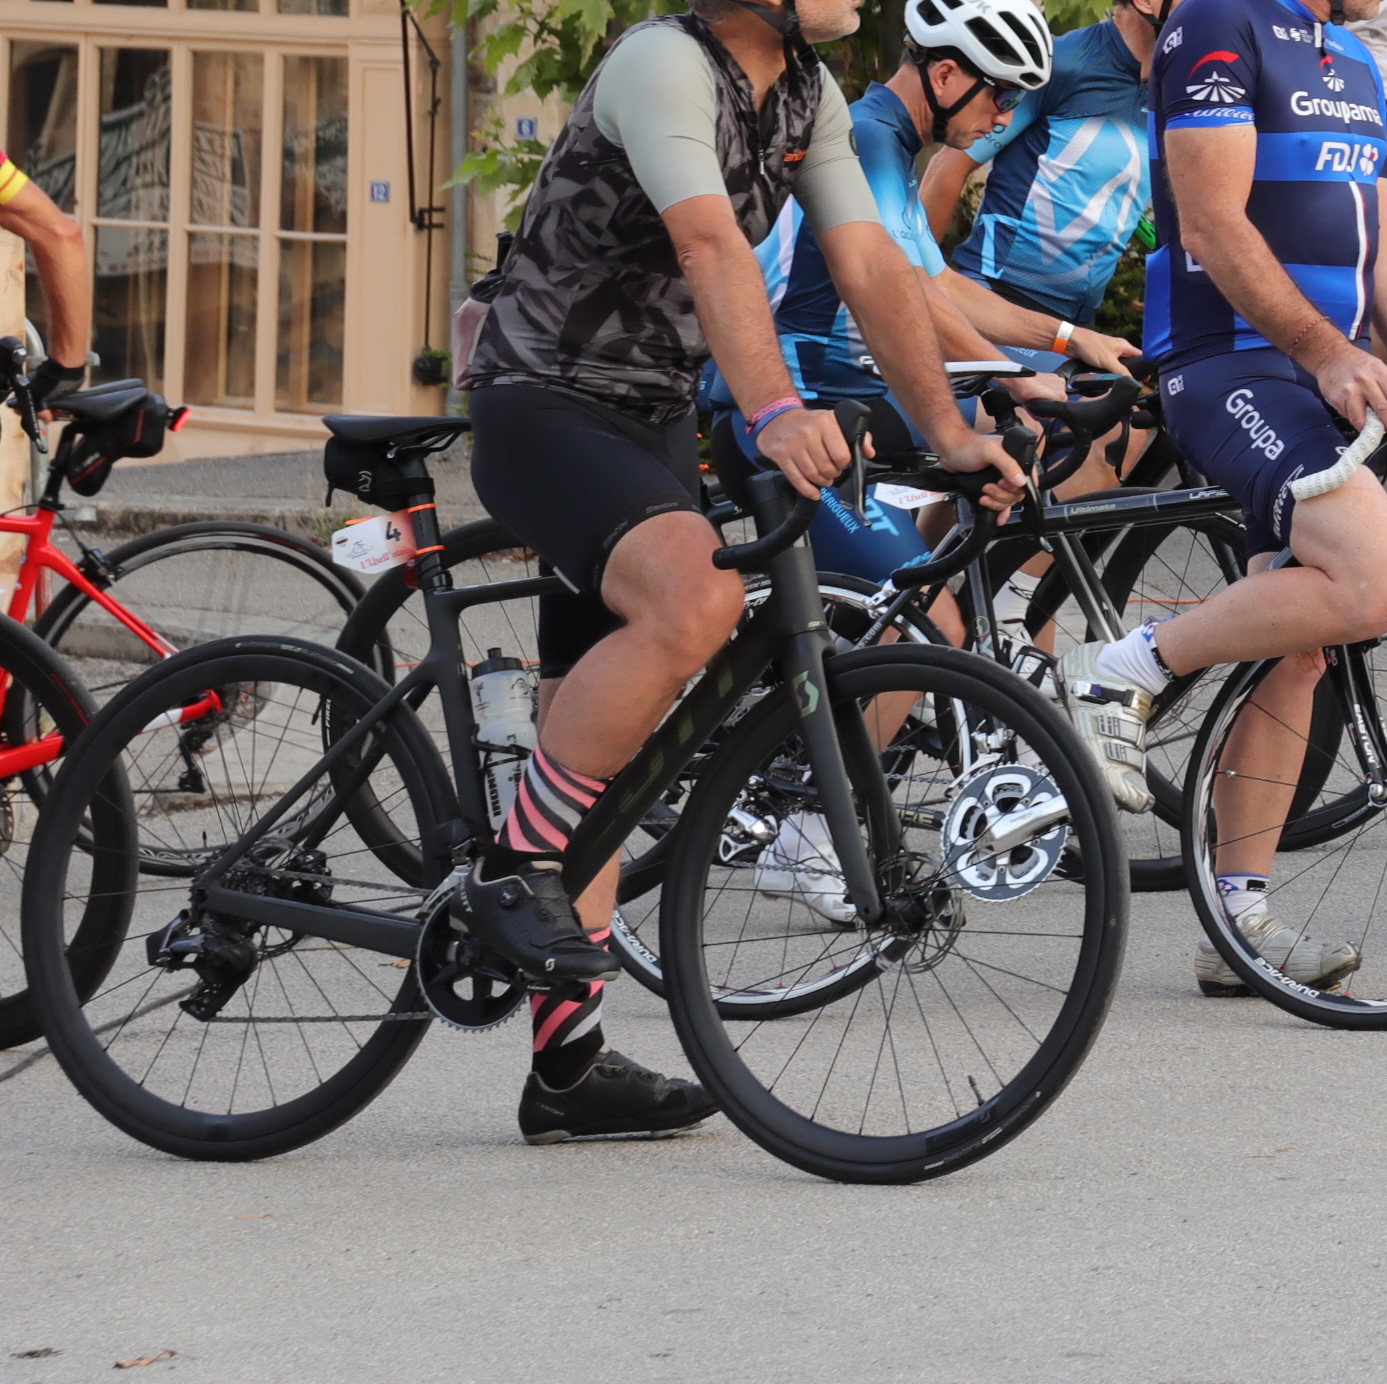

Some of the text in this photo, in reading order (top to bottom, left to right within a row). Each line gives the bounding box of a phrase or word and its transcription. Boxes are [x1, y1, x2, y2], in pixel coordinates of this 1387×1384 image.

[1315, 141, 1360, 172] FDJ
[1226, 389, 1285, 460] Groupa
[1070, 503, 1116, 514] Ultimate
[385, 521, 402, 542] 4
[1254, 957, 1320, 998] DURA-ACE
